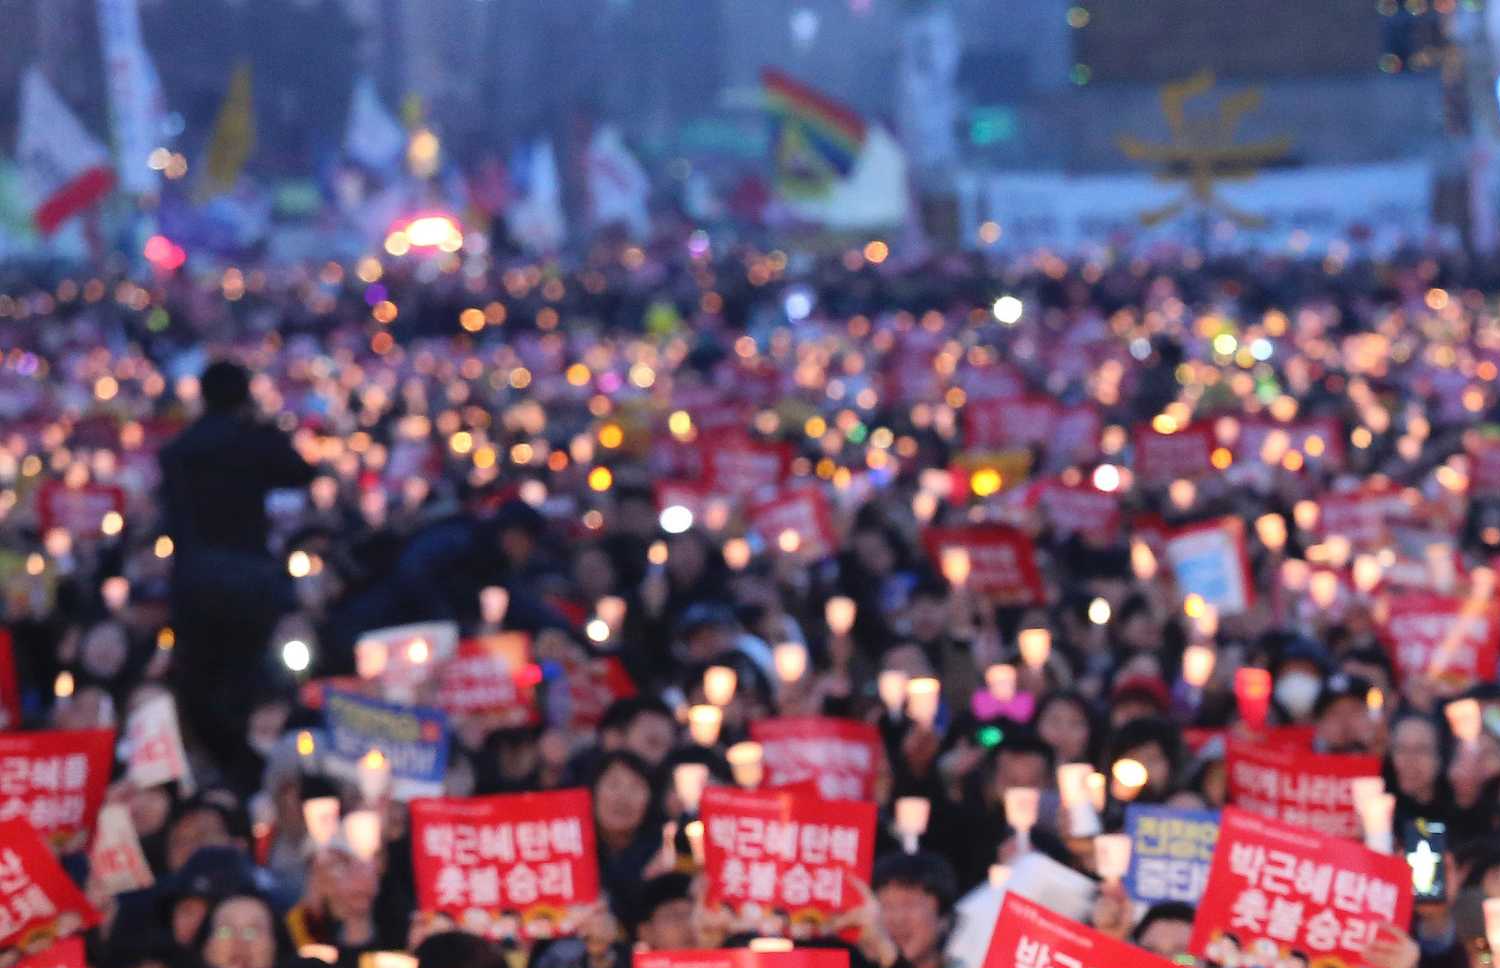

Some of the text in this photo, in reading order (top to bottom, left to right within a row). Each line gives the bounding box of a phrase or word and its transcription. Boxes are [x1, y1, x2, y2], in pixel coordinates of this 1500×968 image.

[1228, 840, 1400, 921] 박근혜 탄핵
[1230, 887, 1305, 943] 촛불
